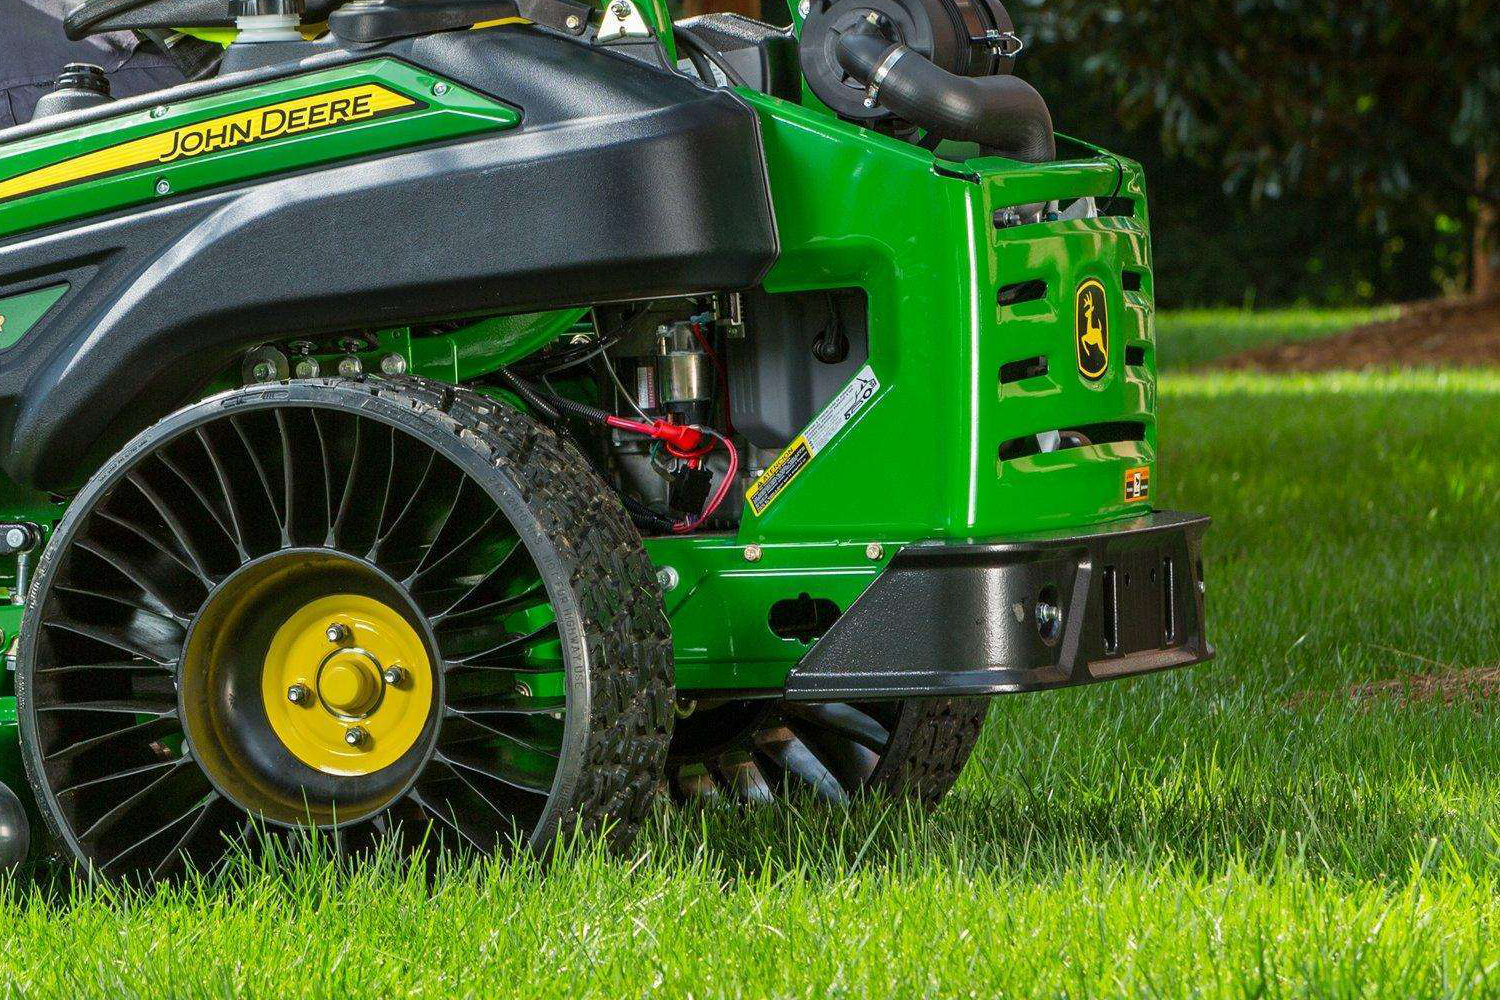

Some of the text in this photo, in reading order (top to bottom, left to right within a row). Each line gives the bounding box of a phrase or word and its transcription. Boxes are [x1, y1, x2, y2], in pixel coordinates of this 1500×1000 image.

[159, 93, 373, 159] JOHN DEERE
[562, 608, 582, 661] HIGHWAY
[573, 664, 585, 689] USE
